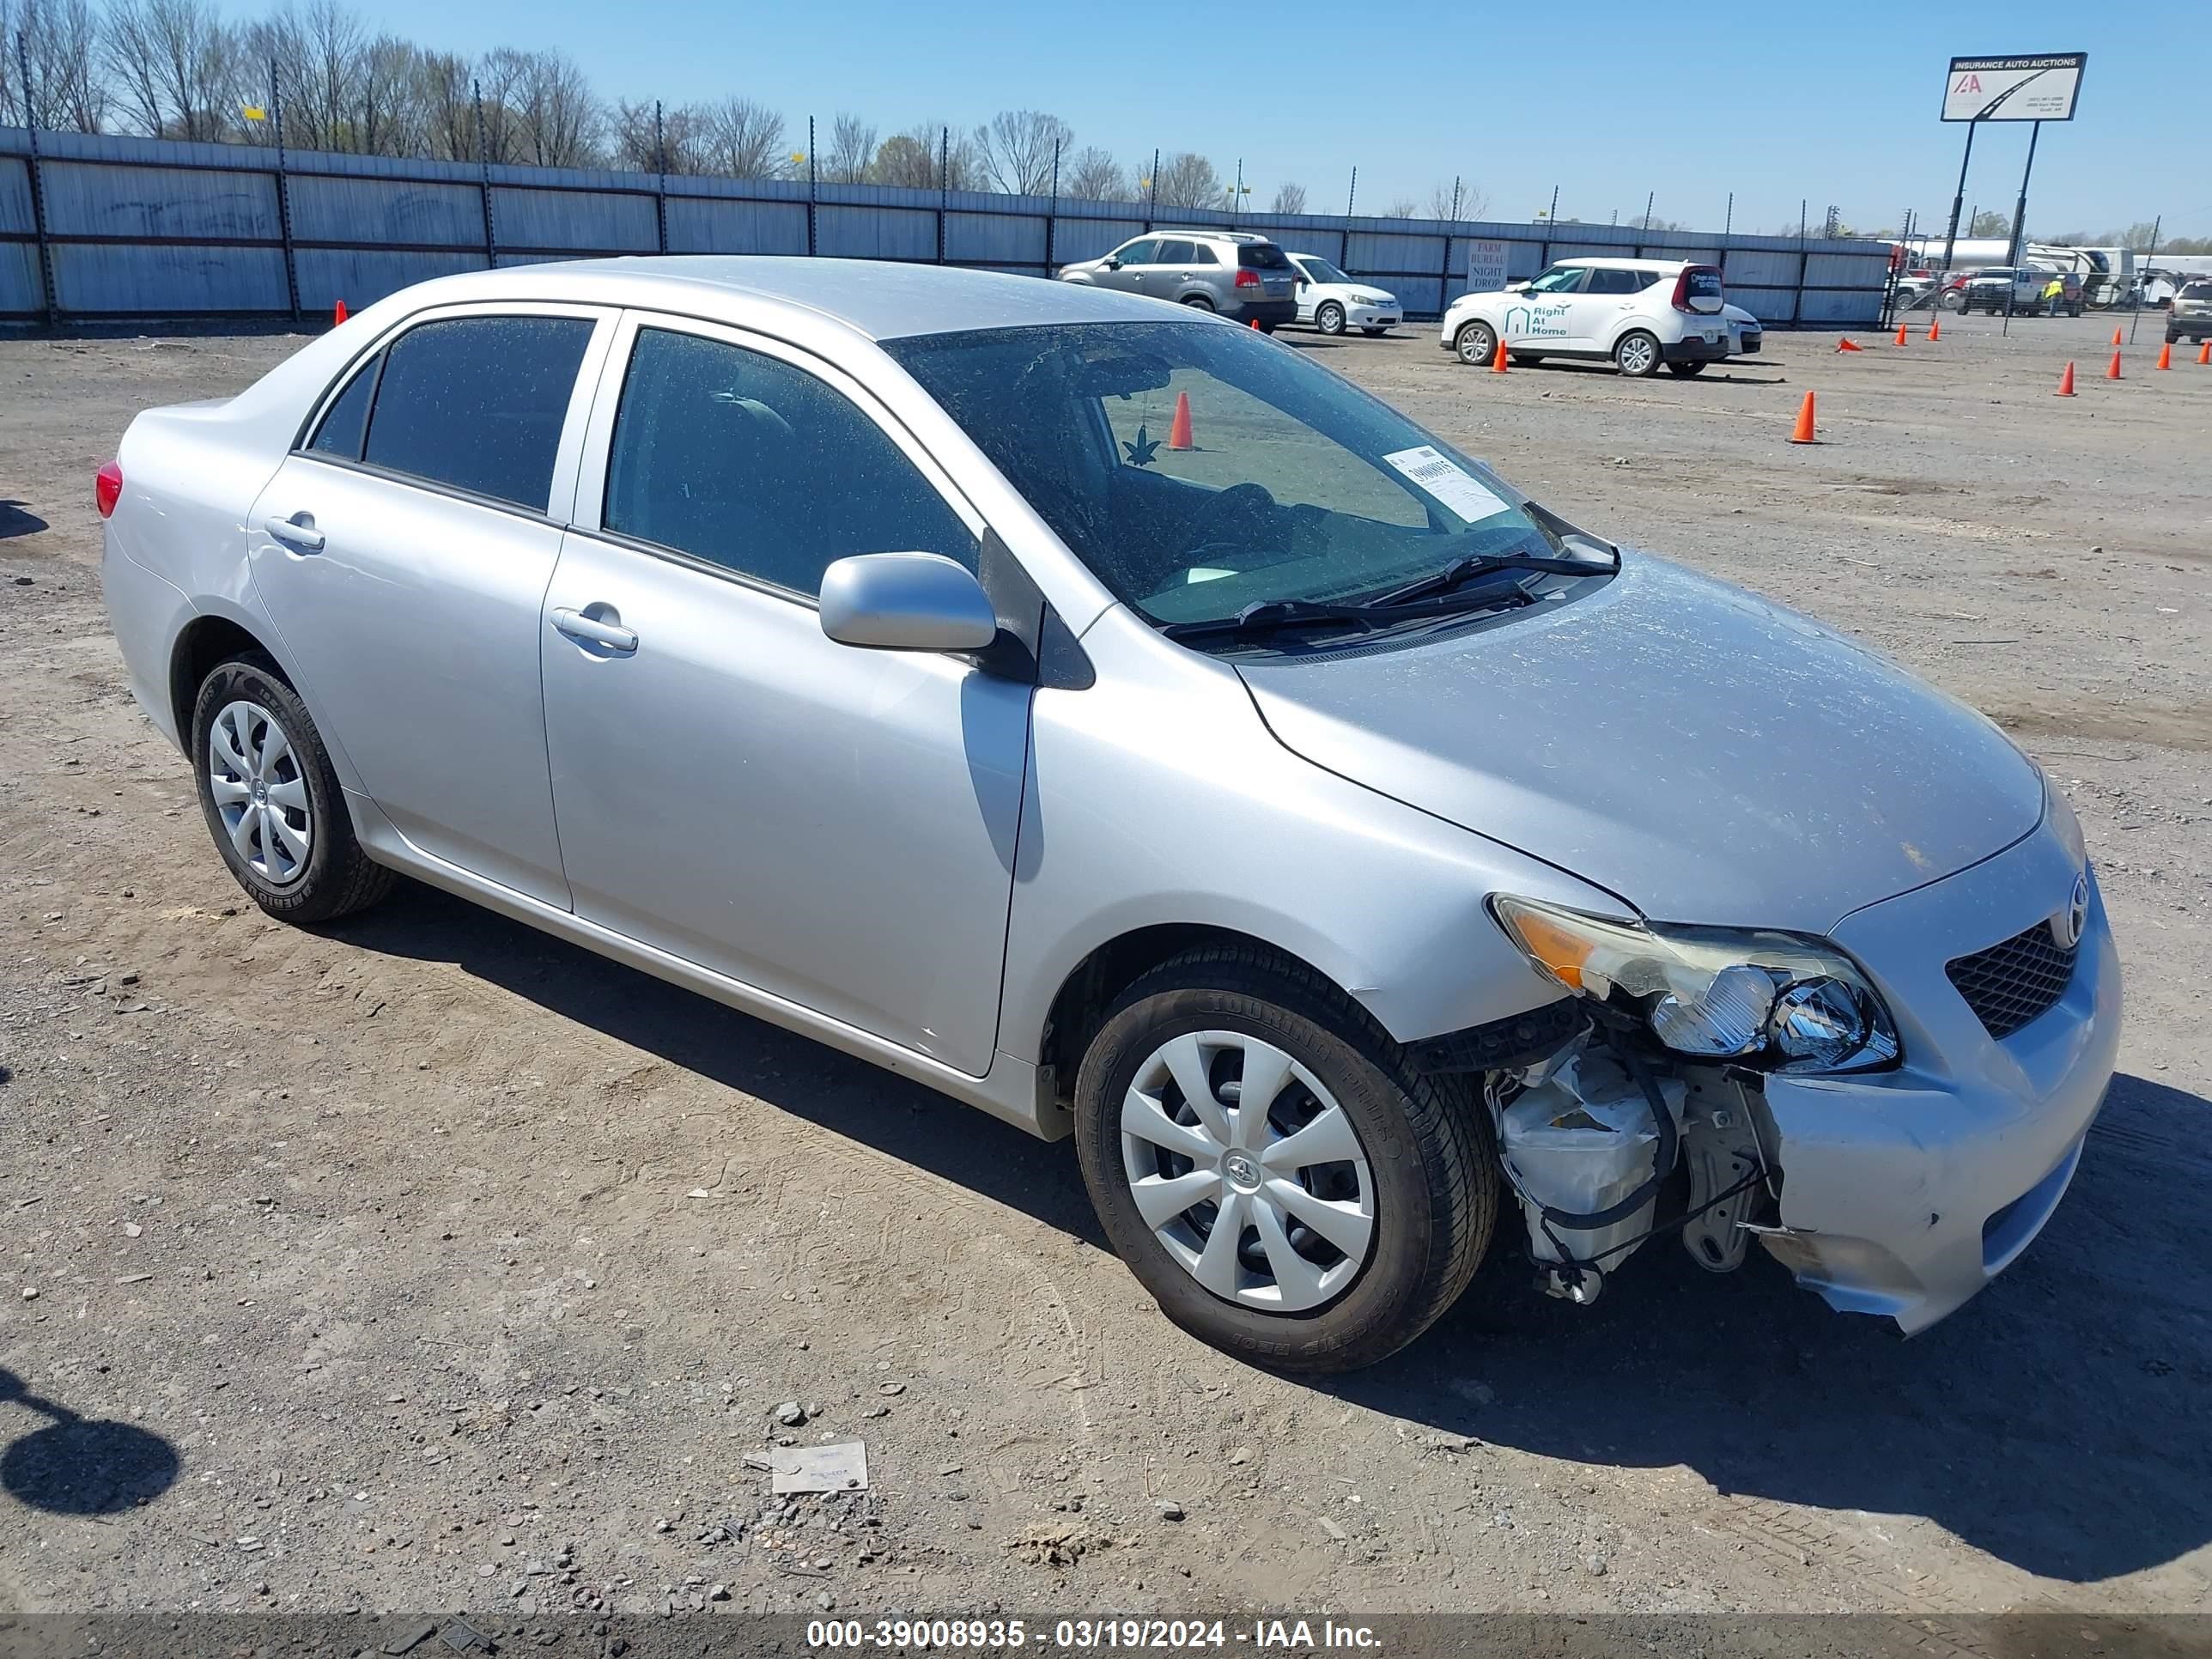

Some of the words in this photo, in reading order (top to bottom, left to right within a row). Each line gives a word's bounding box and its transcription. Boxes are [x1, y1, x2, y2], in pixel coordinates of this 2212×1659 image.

[1955, 61, 2003, 70] INSURANCE
[2005, 60, 2030, 69] AUTO
[2031, 58, 2076, 68] AUCTIONS
[1478, 243, 1502, 252] FARM
[1471, 253, 1505, 264] BUREAU
[1472, 267, 1502, 276] NIGHT
[1474, 278, 1501, 288] DROP
[1534, 307, 1565, 319] Right
[1533, 326, 1567, 336] Home
[1209, 994, 1332, 1062] TOURING
